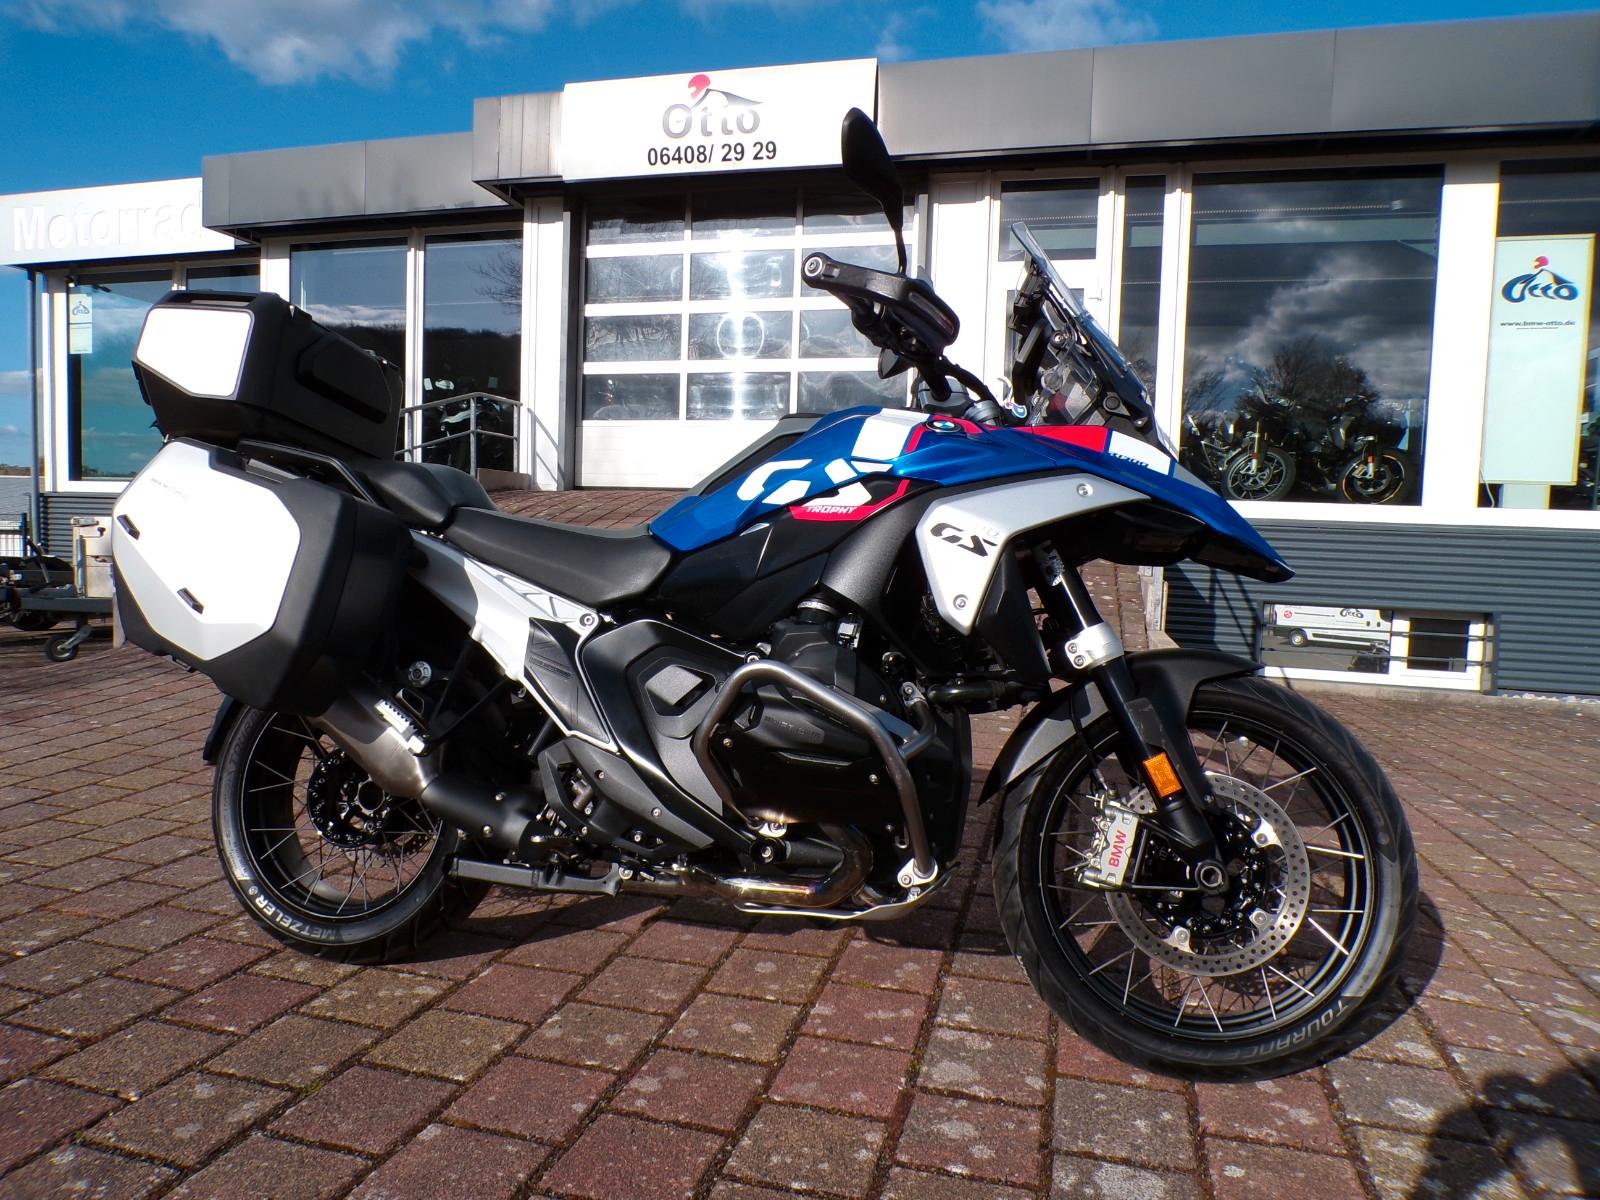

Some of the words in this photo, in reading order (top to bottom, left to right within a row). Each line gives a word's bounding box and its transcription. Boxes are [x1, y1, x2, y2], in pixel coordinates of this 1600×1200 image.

[662, 103, 761, 139] Otto
[648, 143, 714, 167] 06408/
[721, 142, 745, 162] 29
[752, 140, 777, 161] 29
[736, 457, 893, 508] GS
[805, 505, 858, 514] TROPHY
[929, 522, 998, 557] GS
[1108, 829, 1127, 868] BMW
[255, 894, 336, 940] METZELER
